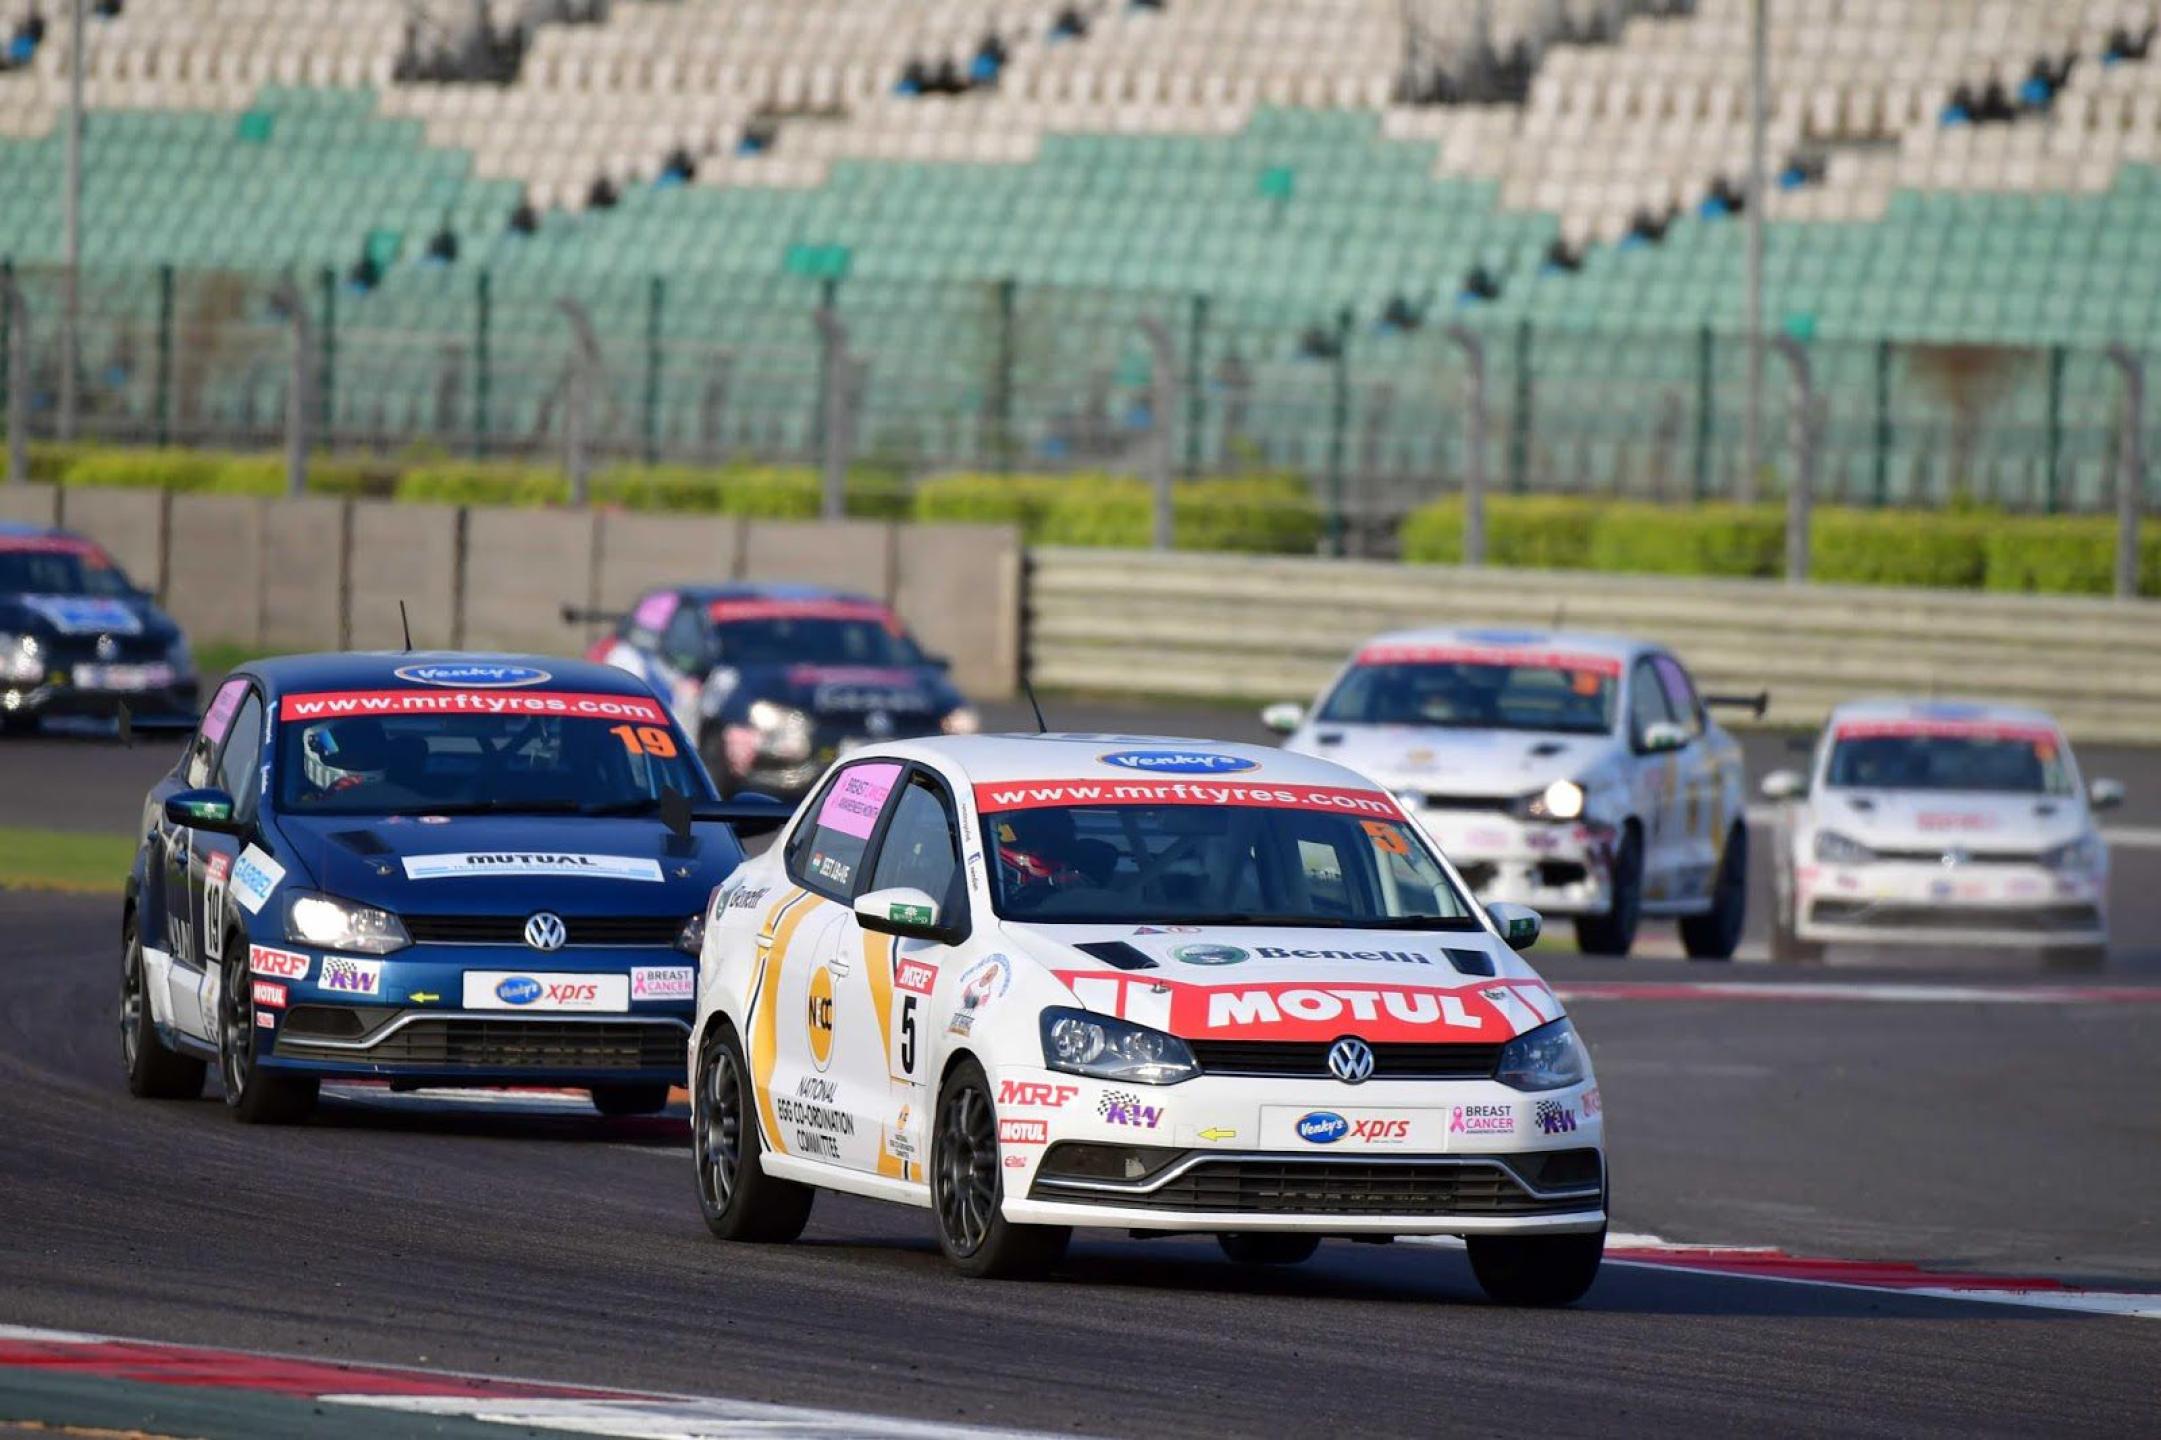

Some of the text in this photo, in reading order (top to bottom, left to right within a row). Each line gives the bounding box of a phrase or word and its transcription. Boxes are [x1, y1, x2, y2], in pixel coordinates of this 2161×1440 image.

[417, 665, 526, 681] Venky's
[295, 694, 655, 720] www.mrftyres.com
[610, 725, 678, 758] 19
[1117, 752, 1237, 769] Venky's
[993, 782, 1392, 814] www.mrftyres.com
[1364, 820, 1409, 856] 5
[466, 855, 597, 867] MUTUAL
[207, 882, 221, 953] 19
[252, 948, 306, 976] MRF
[1255, 946, 1432, 965] Benelli
[647, 970, 689, 981] BREAST
[648, 981, 692, 992] CANCER
[900, 966, 932, 990] MRF
[253, 982, 286, 1003] MOTUL
[545, 984, 598, 1005] xprs
[1207, 989, 1482, 1029] MOTUL
[902, 995, 917, 1075] 5
[796, 1076, 838, 1104] NATIONAL
[998, 1080, 1079, 1108] MRF
[778, 1098, 855, 1136] EGG CO-ORDINATION
[1466, 1106, 1511, 1117] BREAST
[1466, 1117, 1514, 1129] CANCER
[1002, 1122, 1046, 1141] MOTUL
[1301, 1118, 1411, 1143] Venky's xprs
[796, 1130, 841, 1159] COMMITTEE
